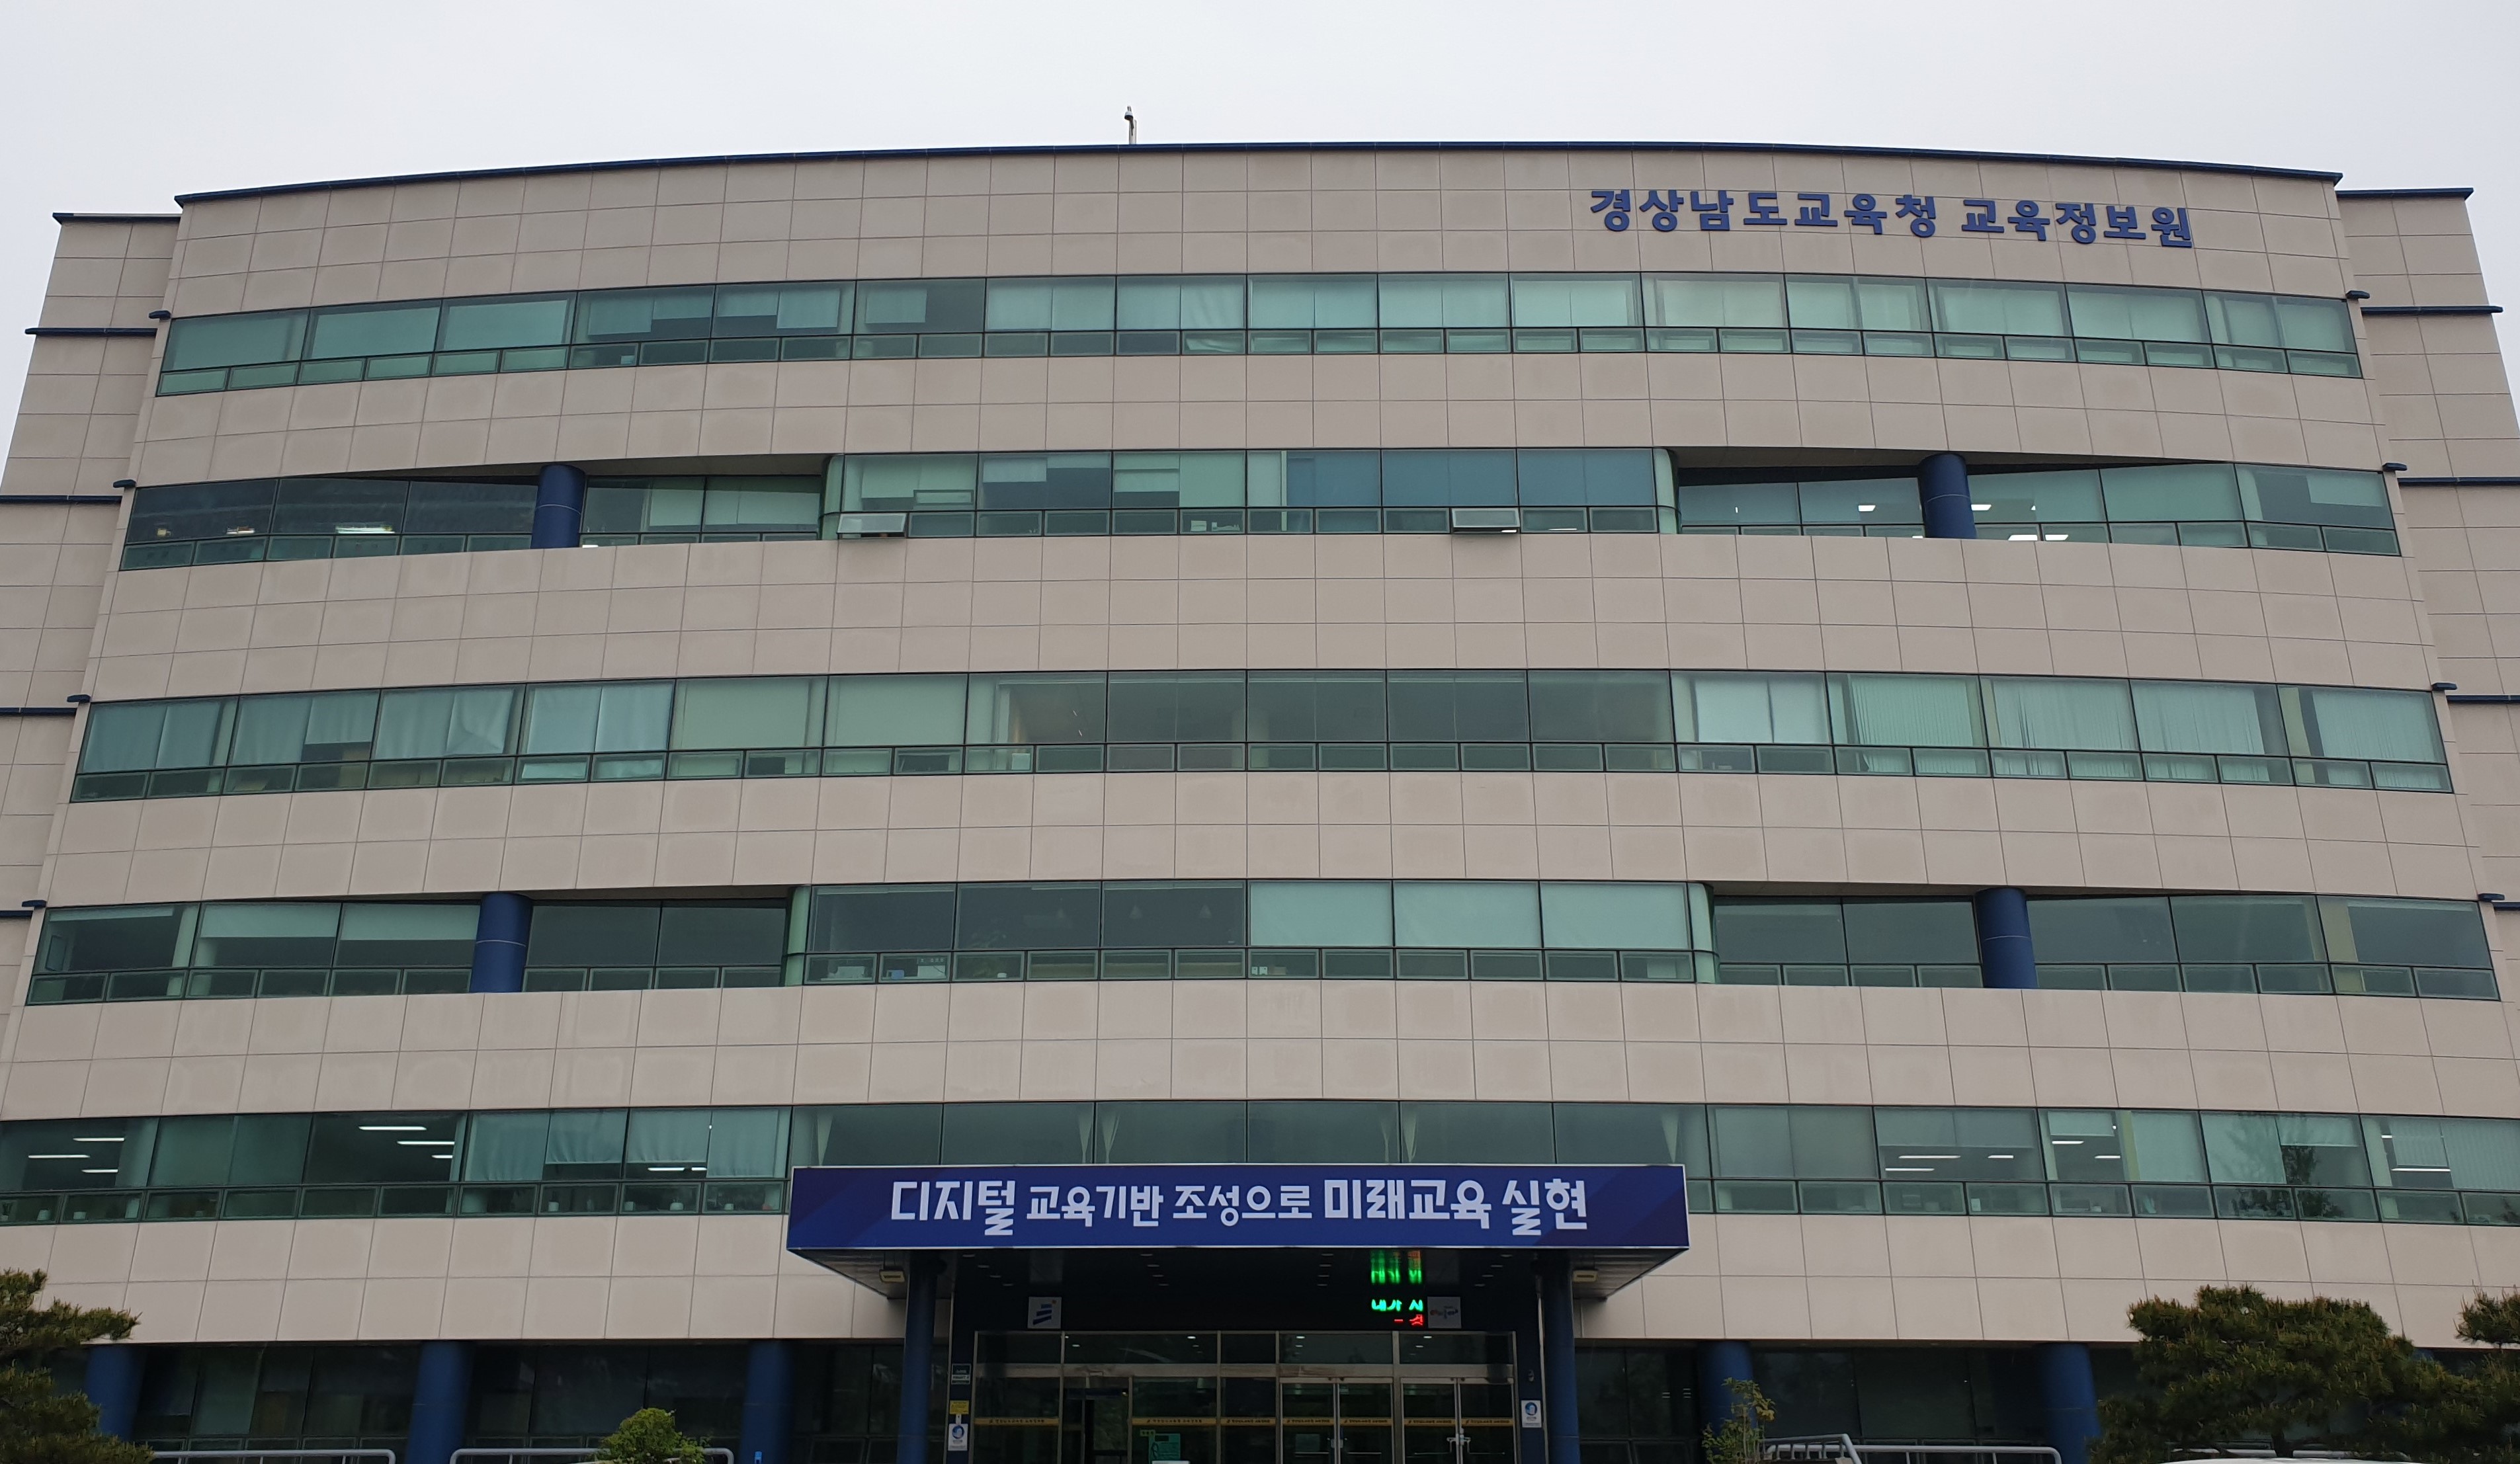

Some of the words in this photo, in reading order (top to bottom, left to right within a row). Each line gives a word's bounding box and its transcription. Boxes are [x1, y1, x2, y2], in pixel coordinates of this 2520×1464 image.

[1591, 189, 1937, 237] 경상남도교육청
[1962, 199, 2193, 248] 교육정보원
[891, 1180, 1015, 1236] 디지털
[1027, 1186, 1164, 1227] 교육기반
[1173, 1185, 1312, 1227] 조성으로
[1324, 1179, 1491, 1229] 미래교육
[1502, 1178, 1587, 1236] 실현
